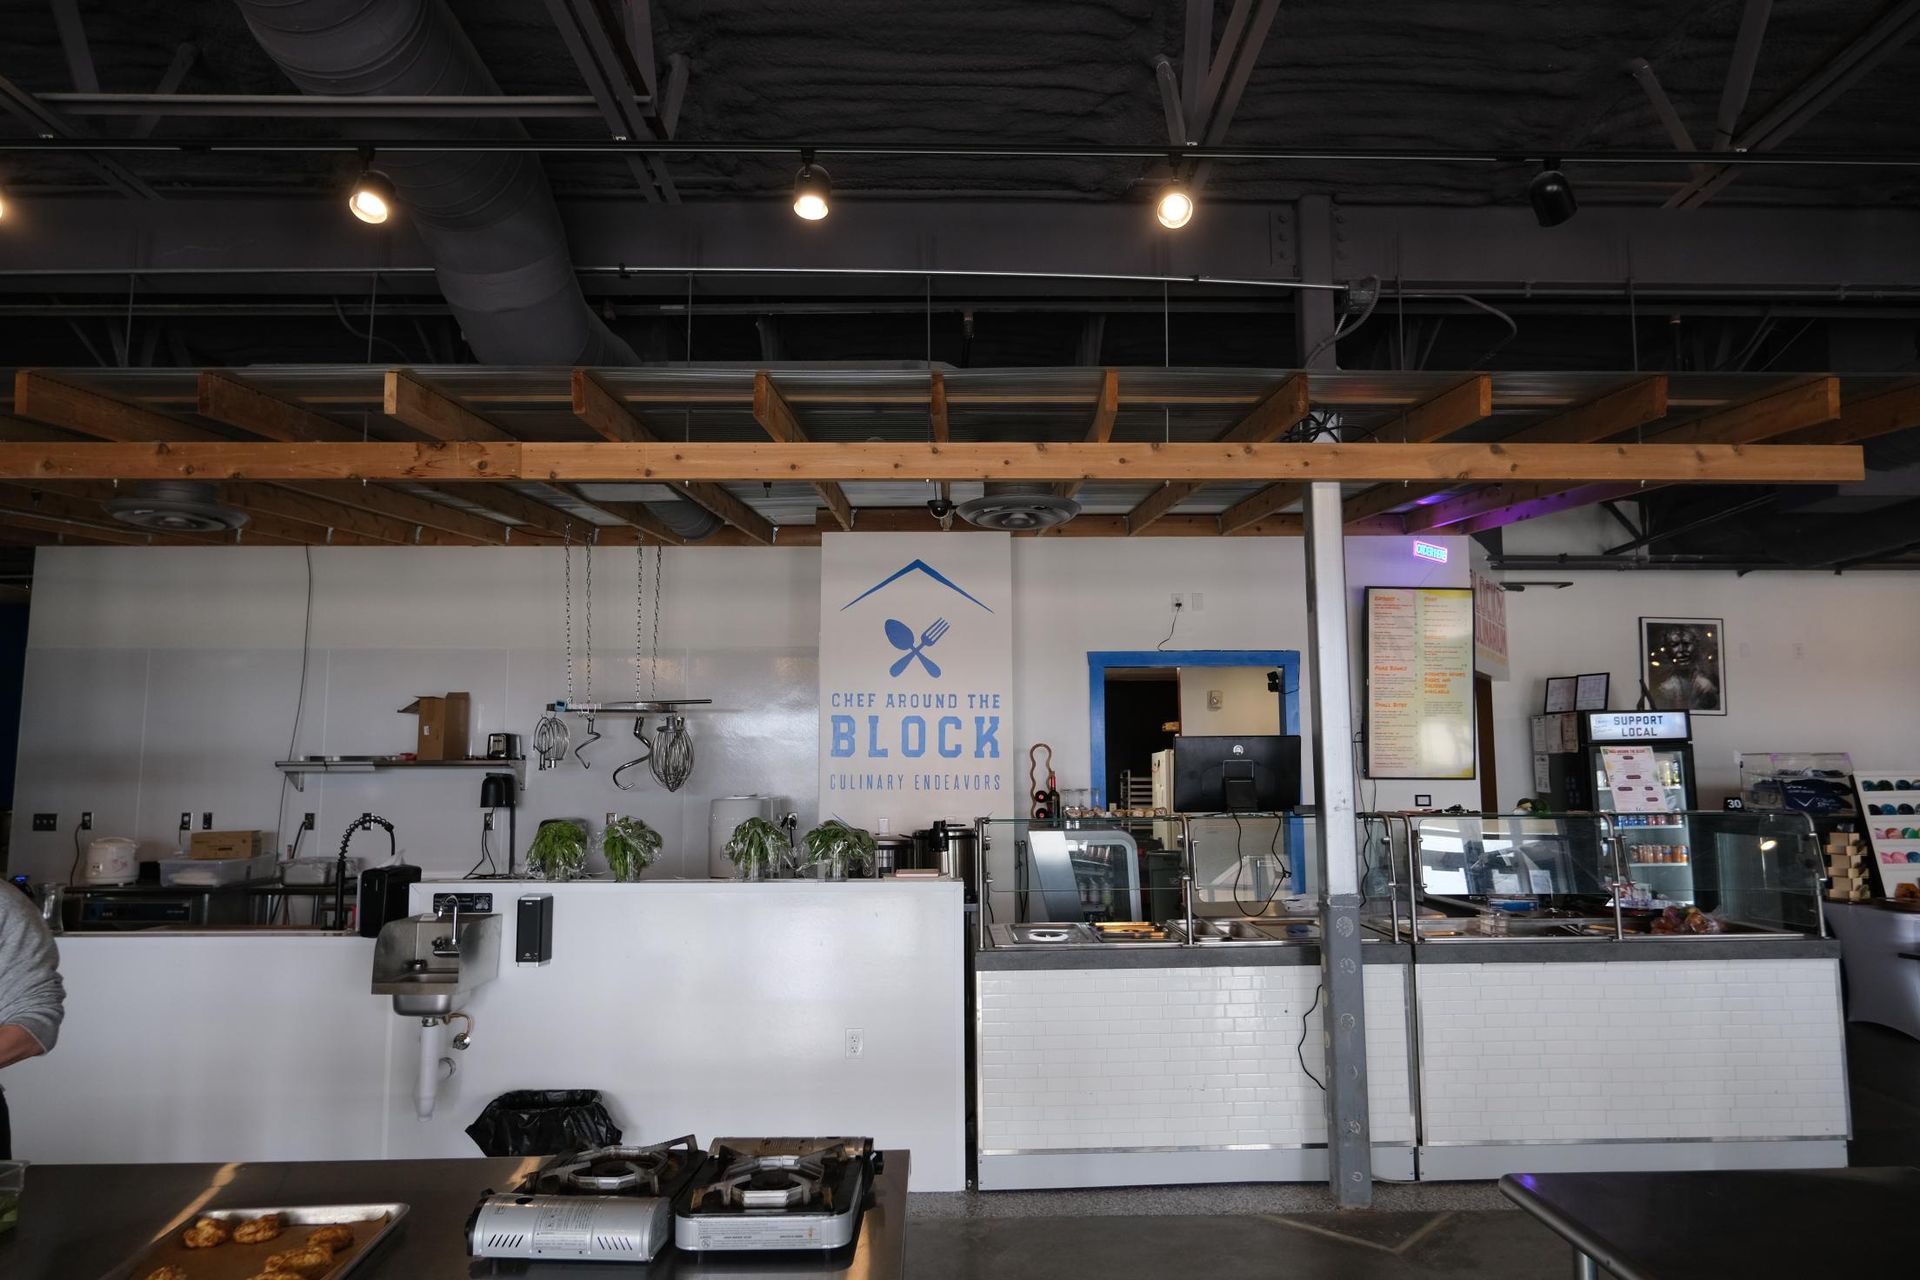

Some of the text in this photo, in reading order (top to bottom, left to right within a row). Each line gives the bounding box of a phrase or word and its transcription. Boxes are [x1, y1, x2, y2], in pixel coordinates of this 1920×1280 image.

[831, 693, 1000, 709] CHEF AROUND THE
[1613, 715, 1663, 726] SUPPORT
[830, 715, 1000, 758] BLOCK
[1621, 727, 1658, 737] LOCAL
[830, 773, 1000, 791] CULINARY ENDEAVORS
[1727, 799, 1742, 809] 30
